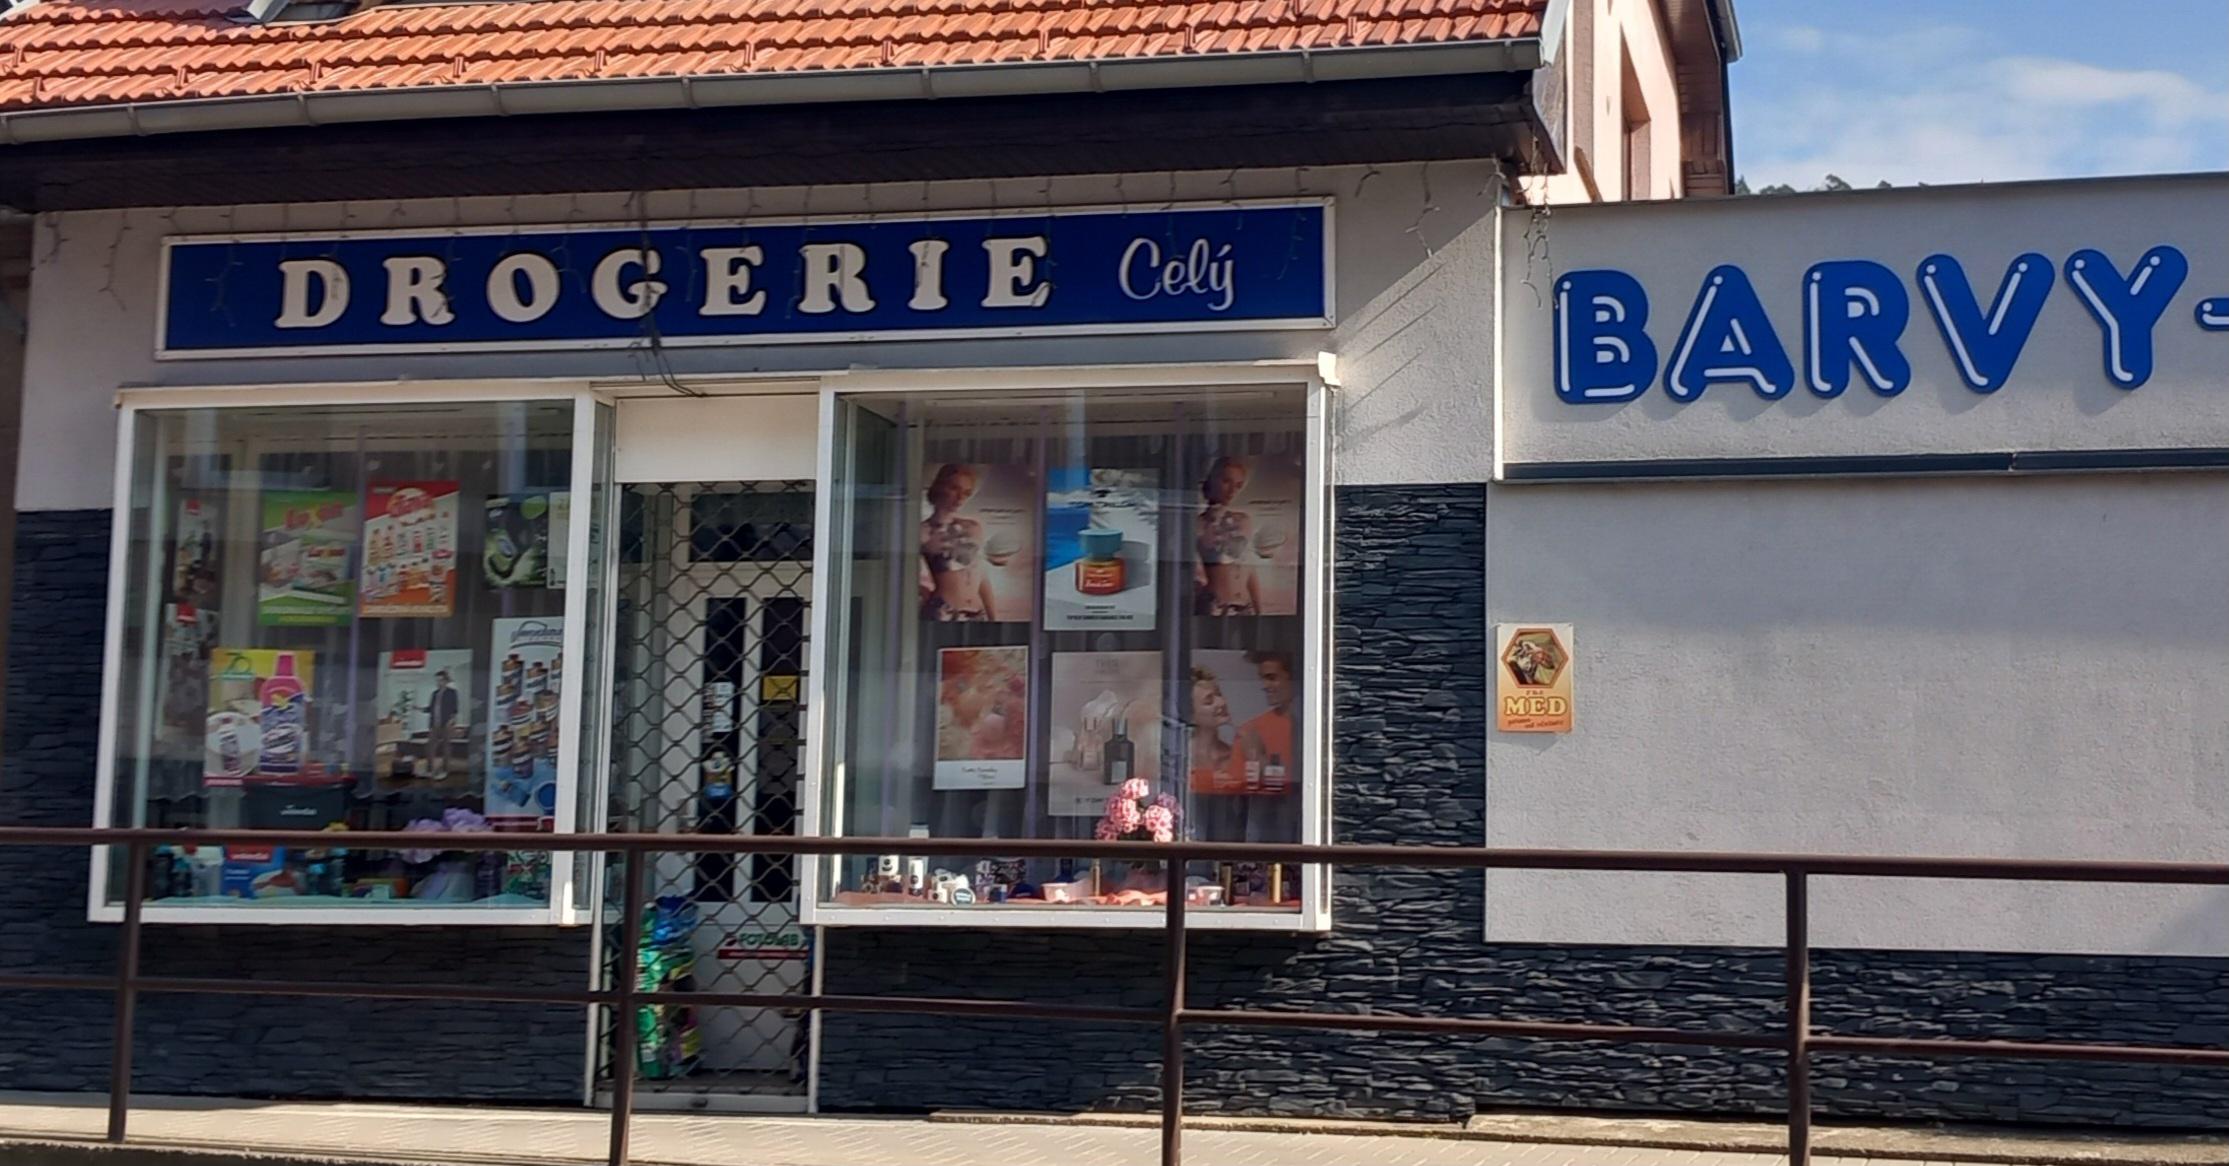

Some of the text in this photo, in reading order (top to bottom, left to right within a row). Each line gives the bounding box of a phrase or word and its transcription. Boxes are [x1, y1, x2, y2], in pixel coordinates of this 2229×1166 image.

[274, 235, 1235, 329] DROGERIE Celý
[1503, 695, 1568, 717] MED
